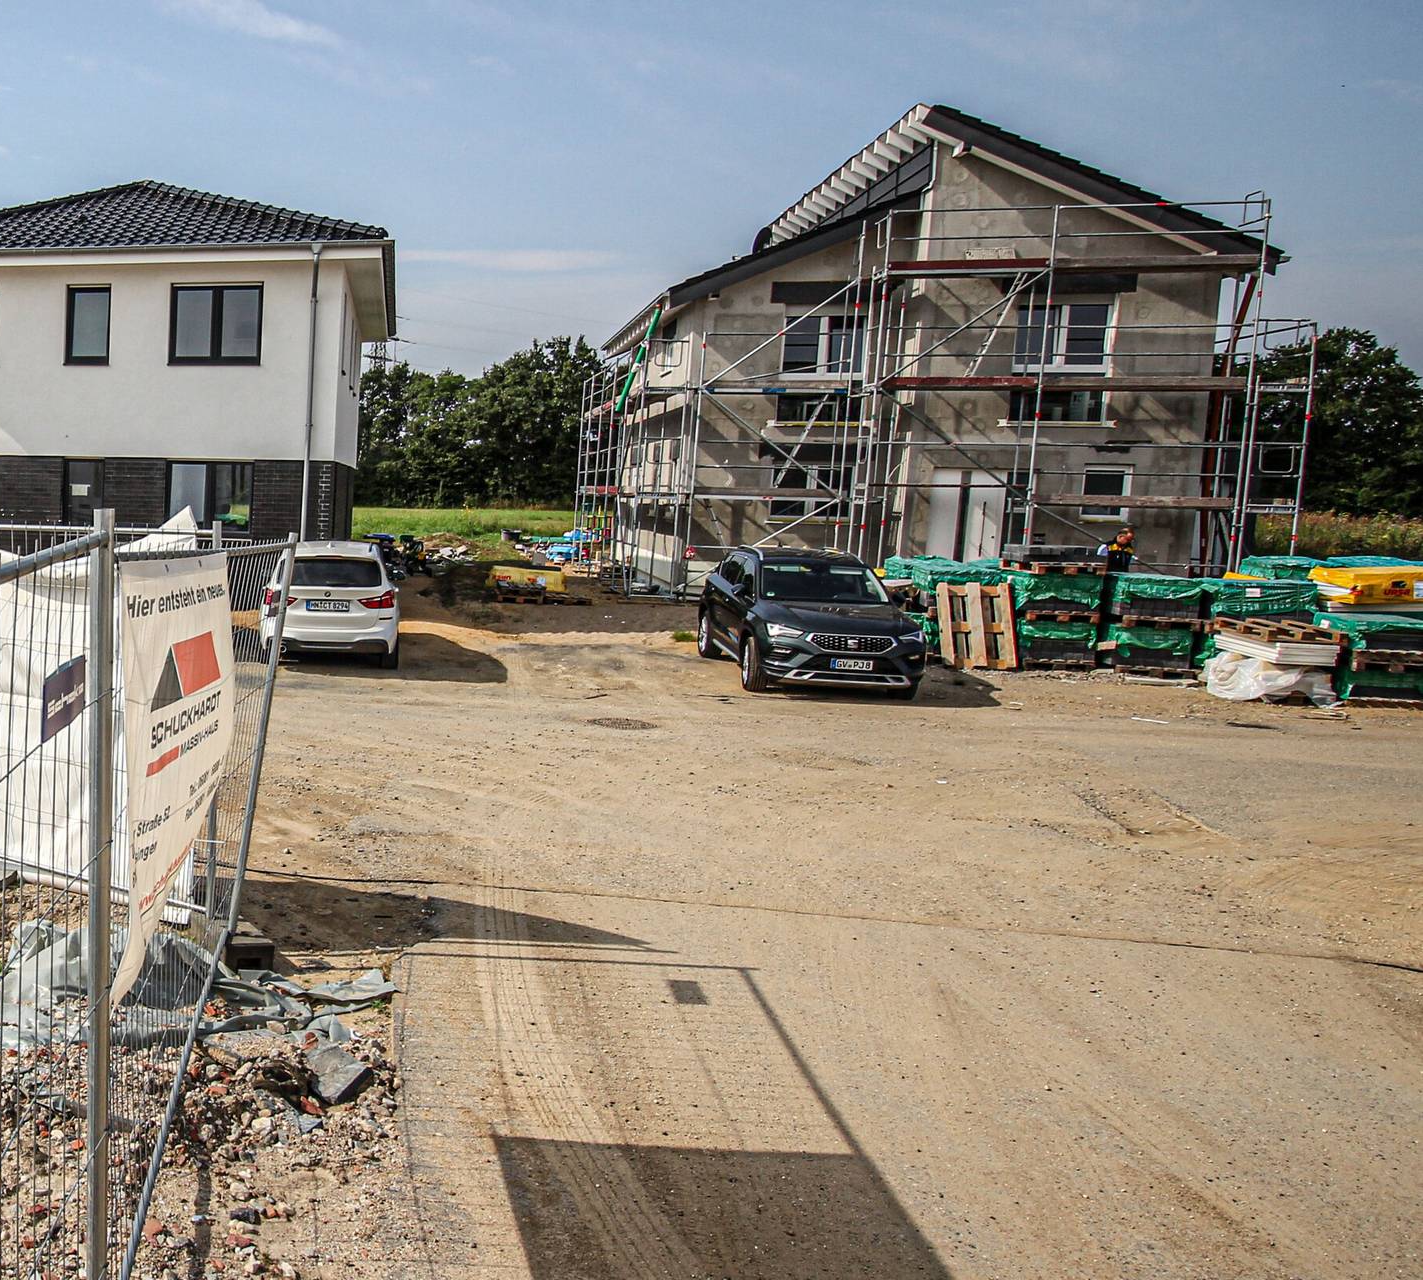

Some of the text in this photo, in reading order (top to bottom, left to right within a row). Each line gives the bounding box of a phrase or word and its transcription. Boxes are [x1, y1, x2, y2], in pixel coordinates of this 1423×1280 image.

[127, 592, 155, 618] Hier
[159, 586, 196, 617] entsteht
[196, 584, 207, 603] ein
[837, 660, 848, 668] GV
[150, 690, 221, 749] SCHUCKHARDT
[180, 719, 219, 758] MASSIV-HAUS
[136, 814, 162, 837] Straße
